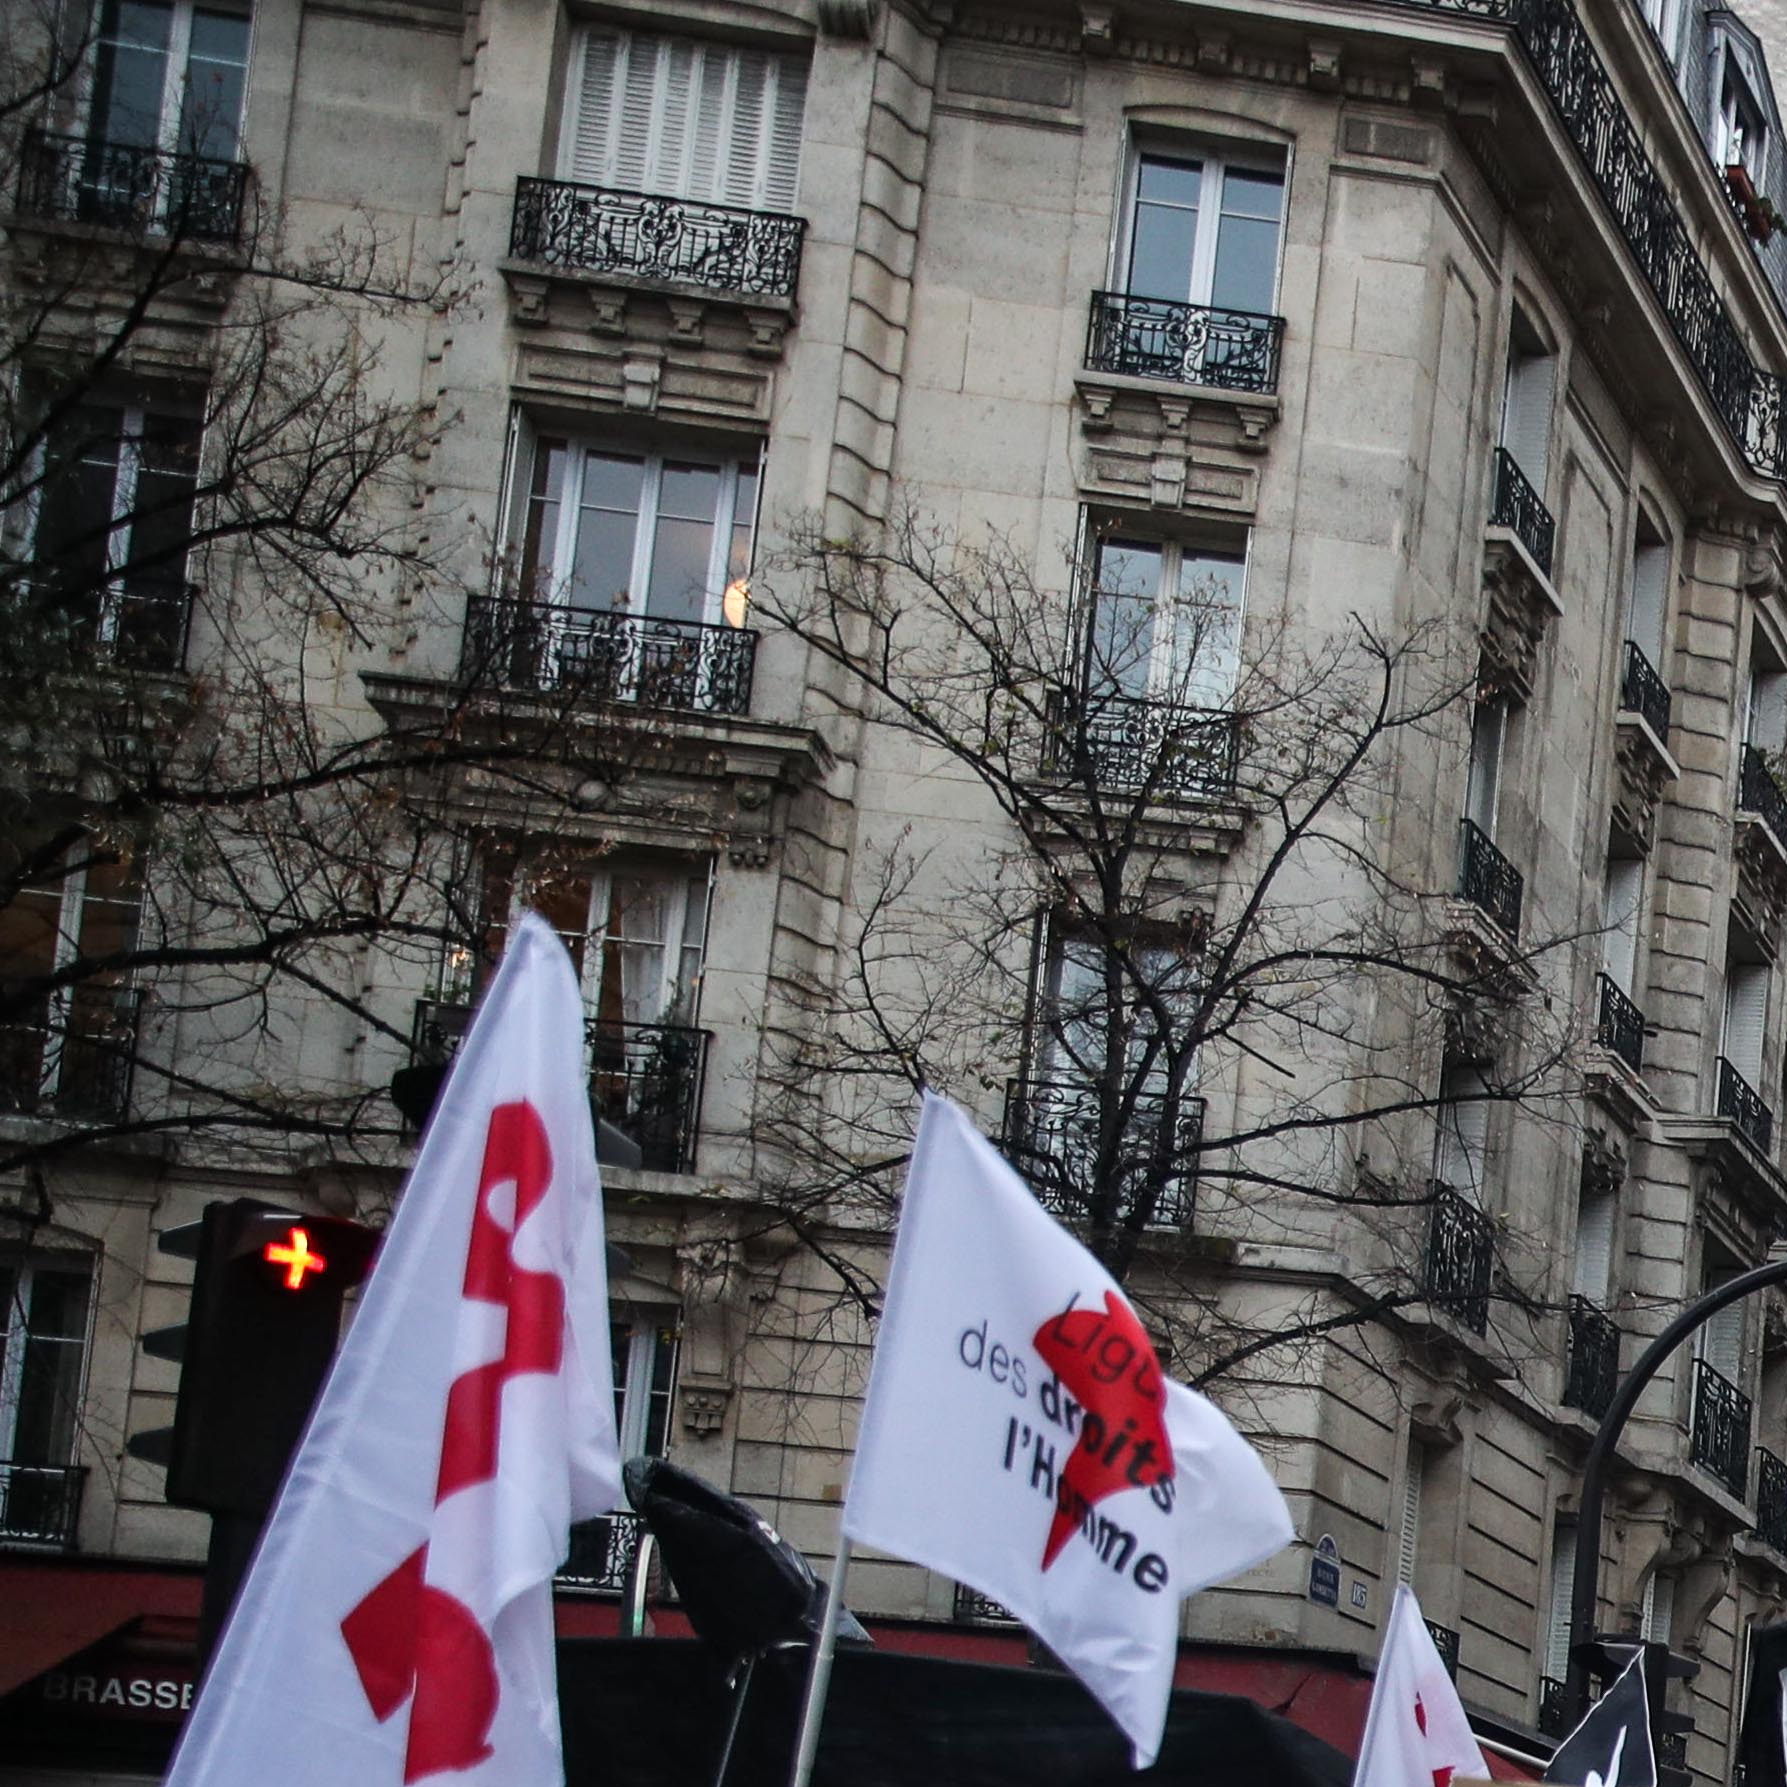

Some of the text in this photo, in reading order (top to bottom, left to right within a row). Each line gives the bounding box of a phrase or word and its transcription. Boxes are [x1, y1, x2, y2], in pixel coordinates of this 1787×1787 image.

[959, 1318, 1177, 1515] des droits
[42, 1674, 195, 1711] BRASSE
